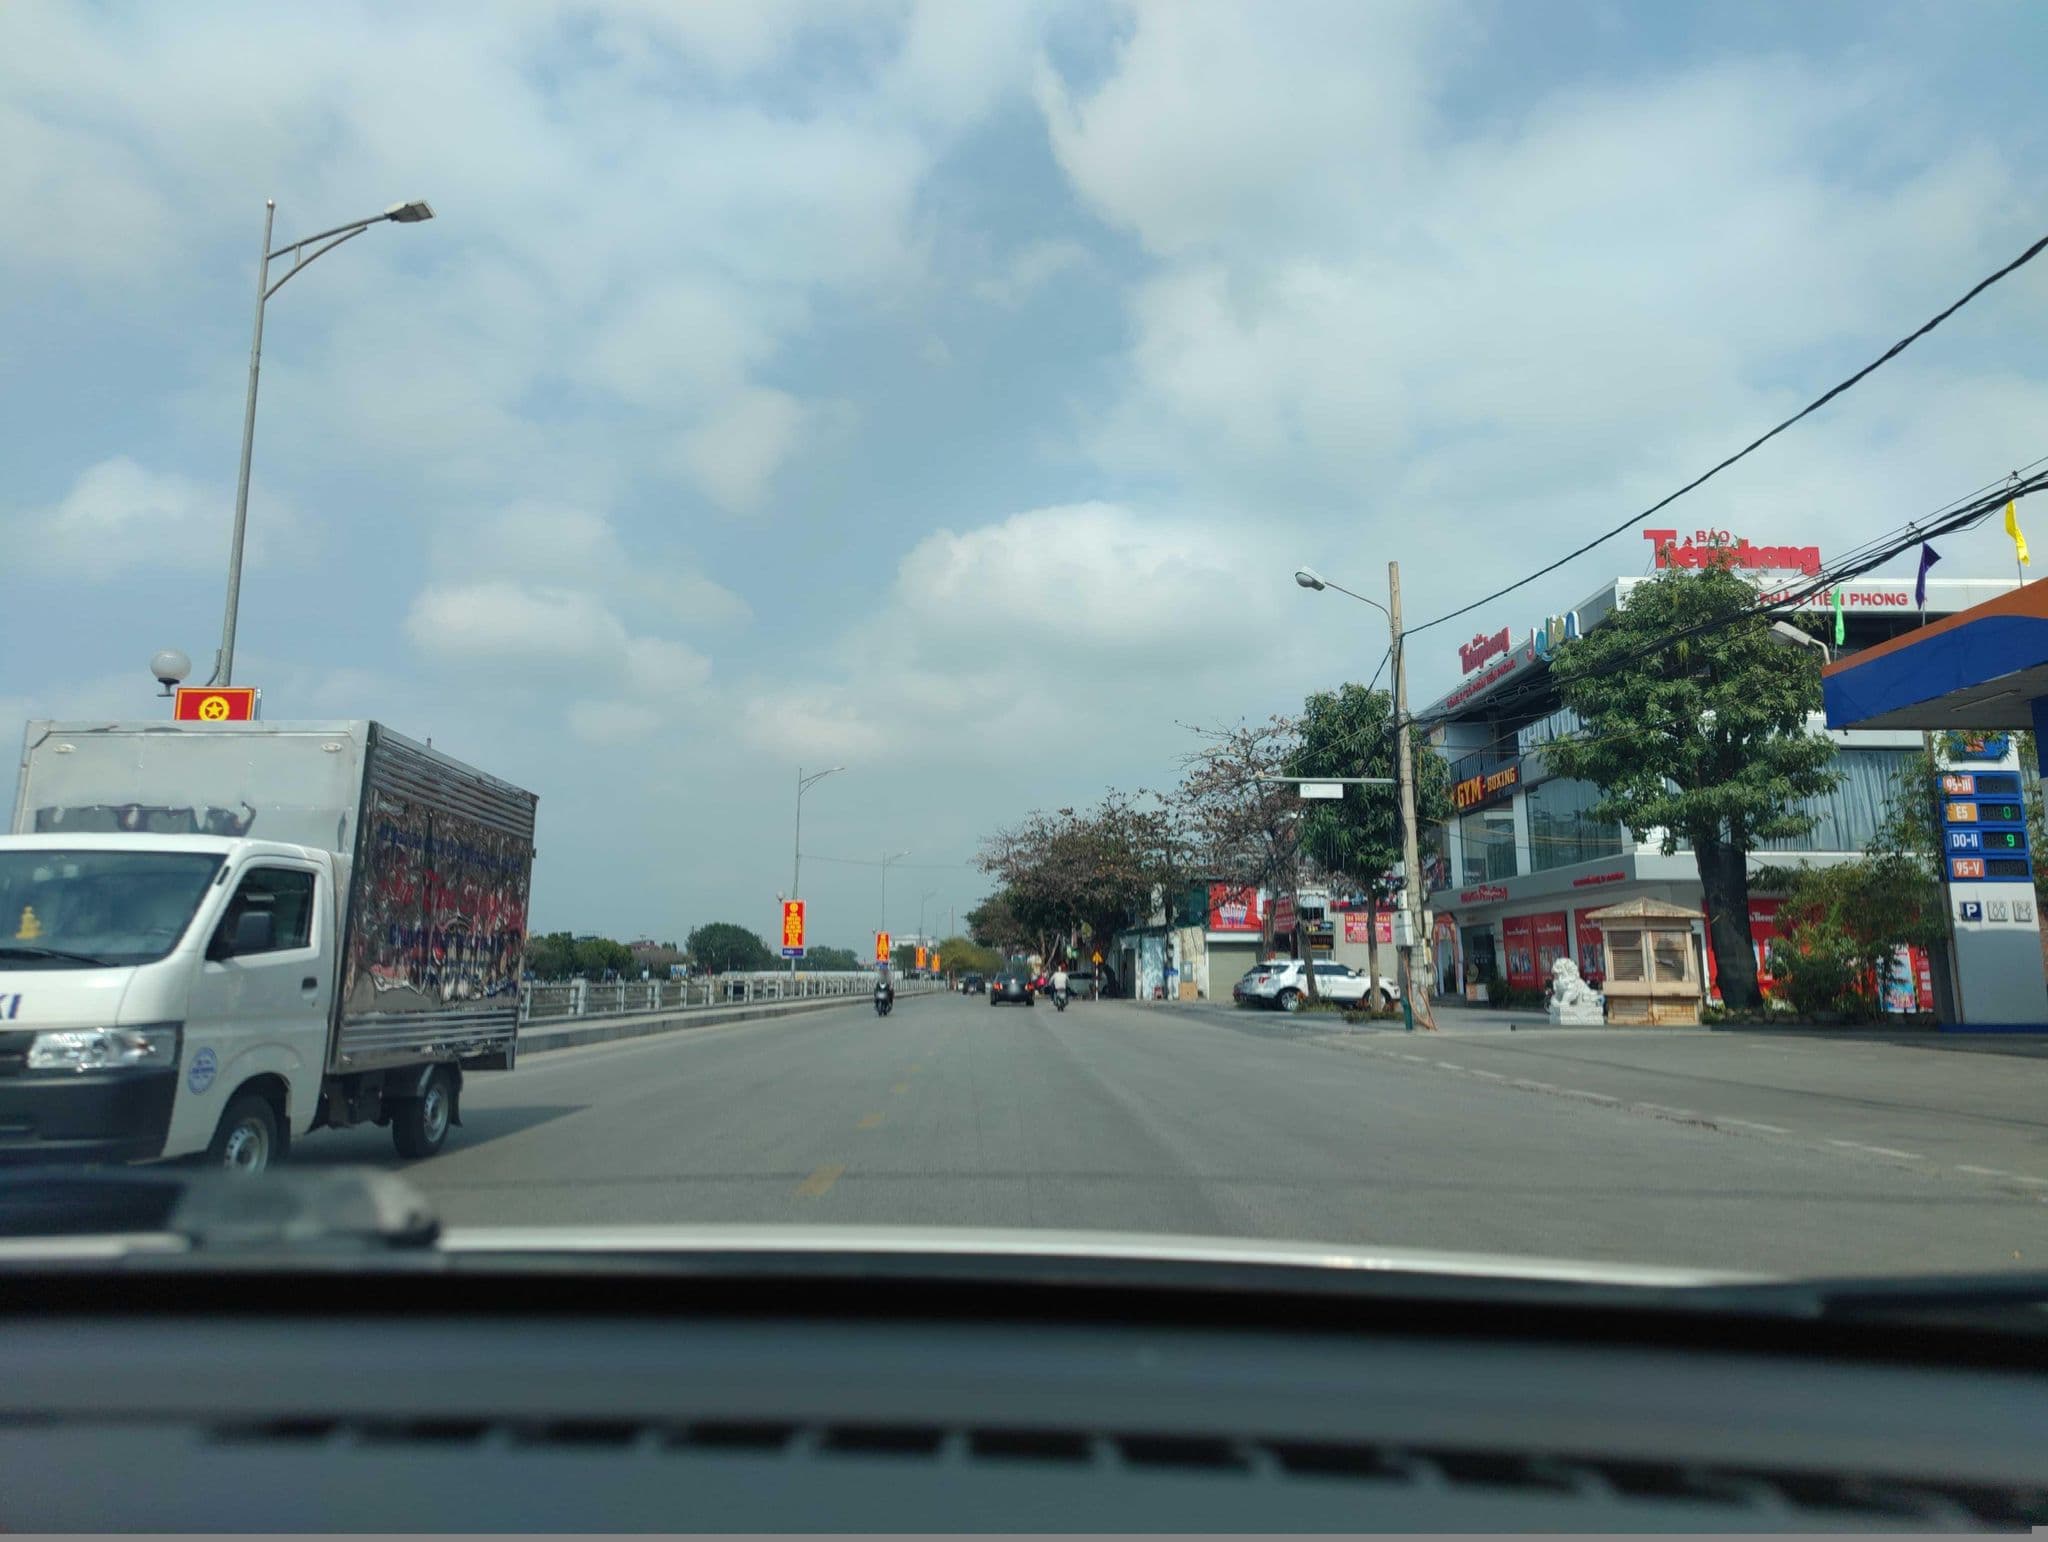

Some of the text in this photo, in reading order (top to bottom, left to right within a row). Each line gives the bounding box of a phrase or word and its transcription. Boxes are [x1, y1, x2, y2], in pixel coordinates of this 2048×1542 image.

[1850, 593, 1908, 606] PHONG
[1457, 766, 1518, 808] GYM BOXING
[1955, 805, 1969, 819] E5
[1952, 834, 1978, 847] DO-II
[1956, 861, 1980, 875] 95-V
